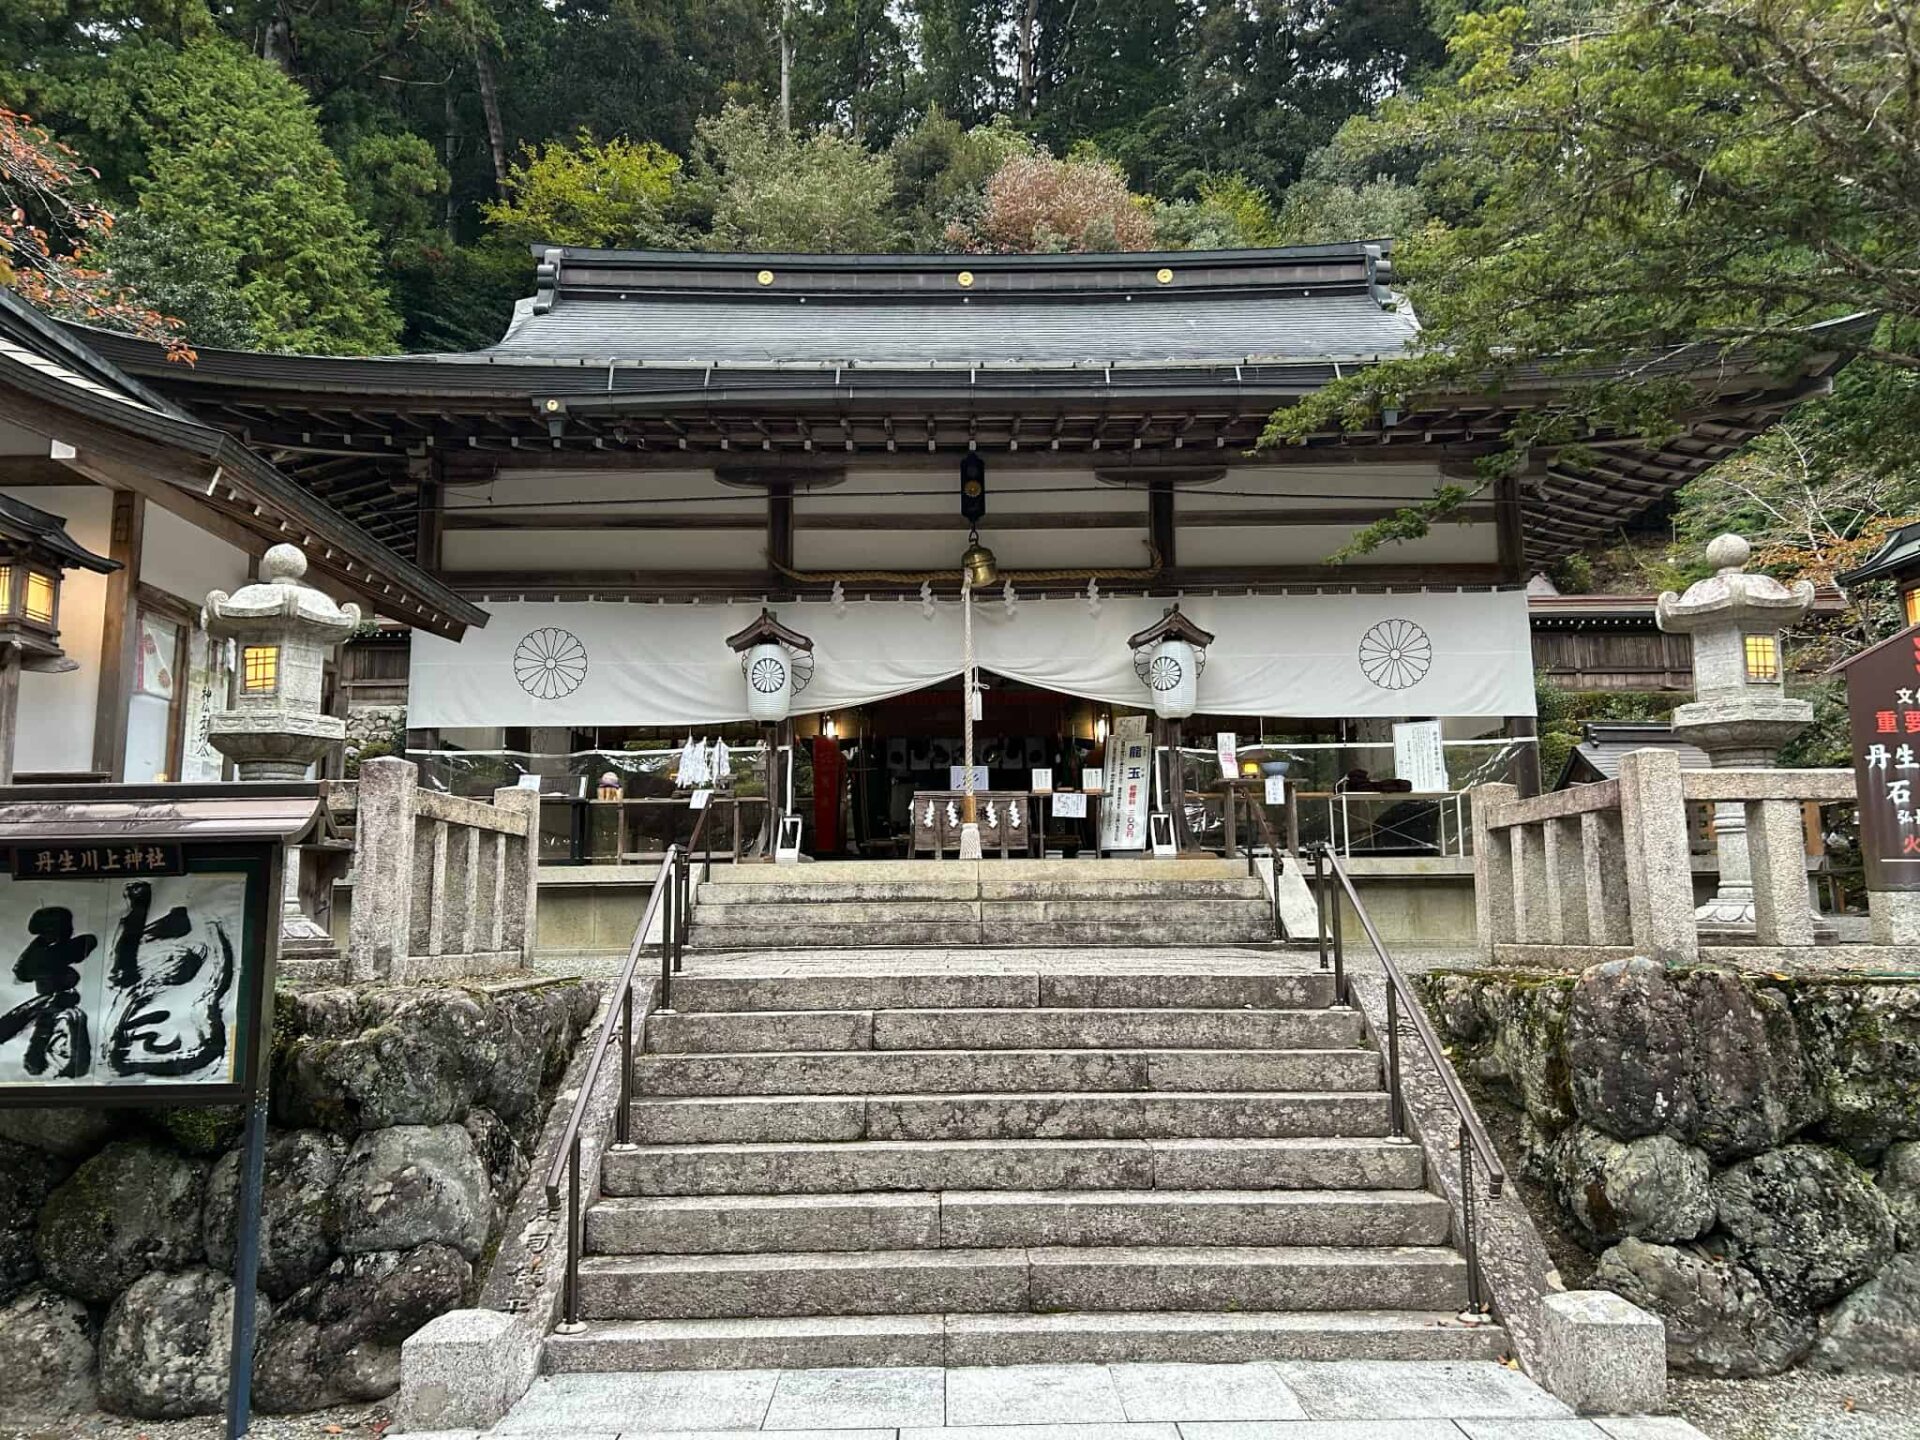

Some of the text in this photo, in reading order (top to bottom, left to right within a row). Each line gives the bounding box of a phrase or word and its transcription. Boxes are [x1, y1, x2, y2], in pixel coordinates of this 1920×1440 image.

[1127, 745, 1142, 779] 龍玉
[1865, 743, 1920, 770] 丹生
[1886, 780, 1911, 805] 石
[34, 846, 167, 872] 丹生川上神社
